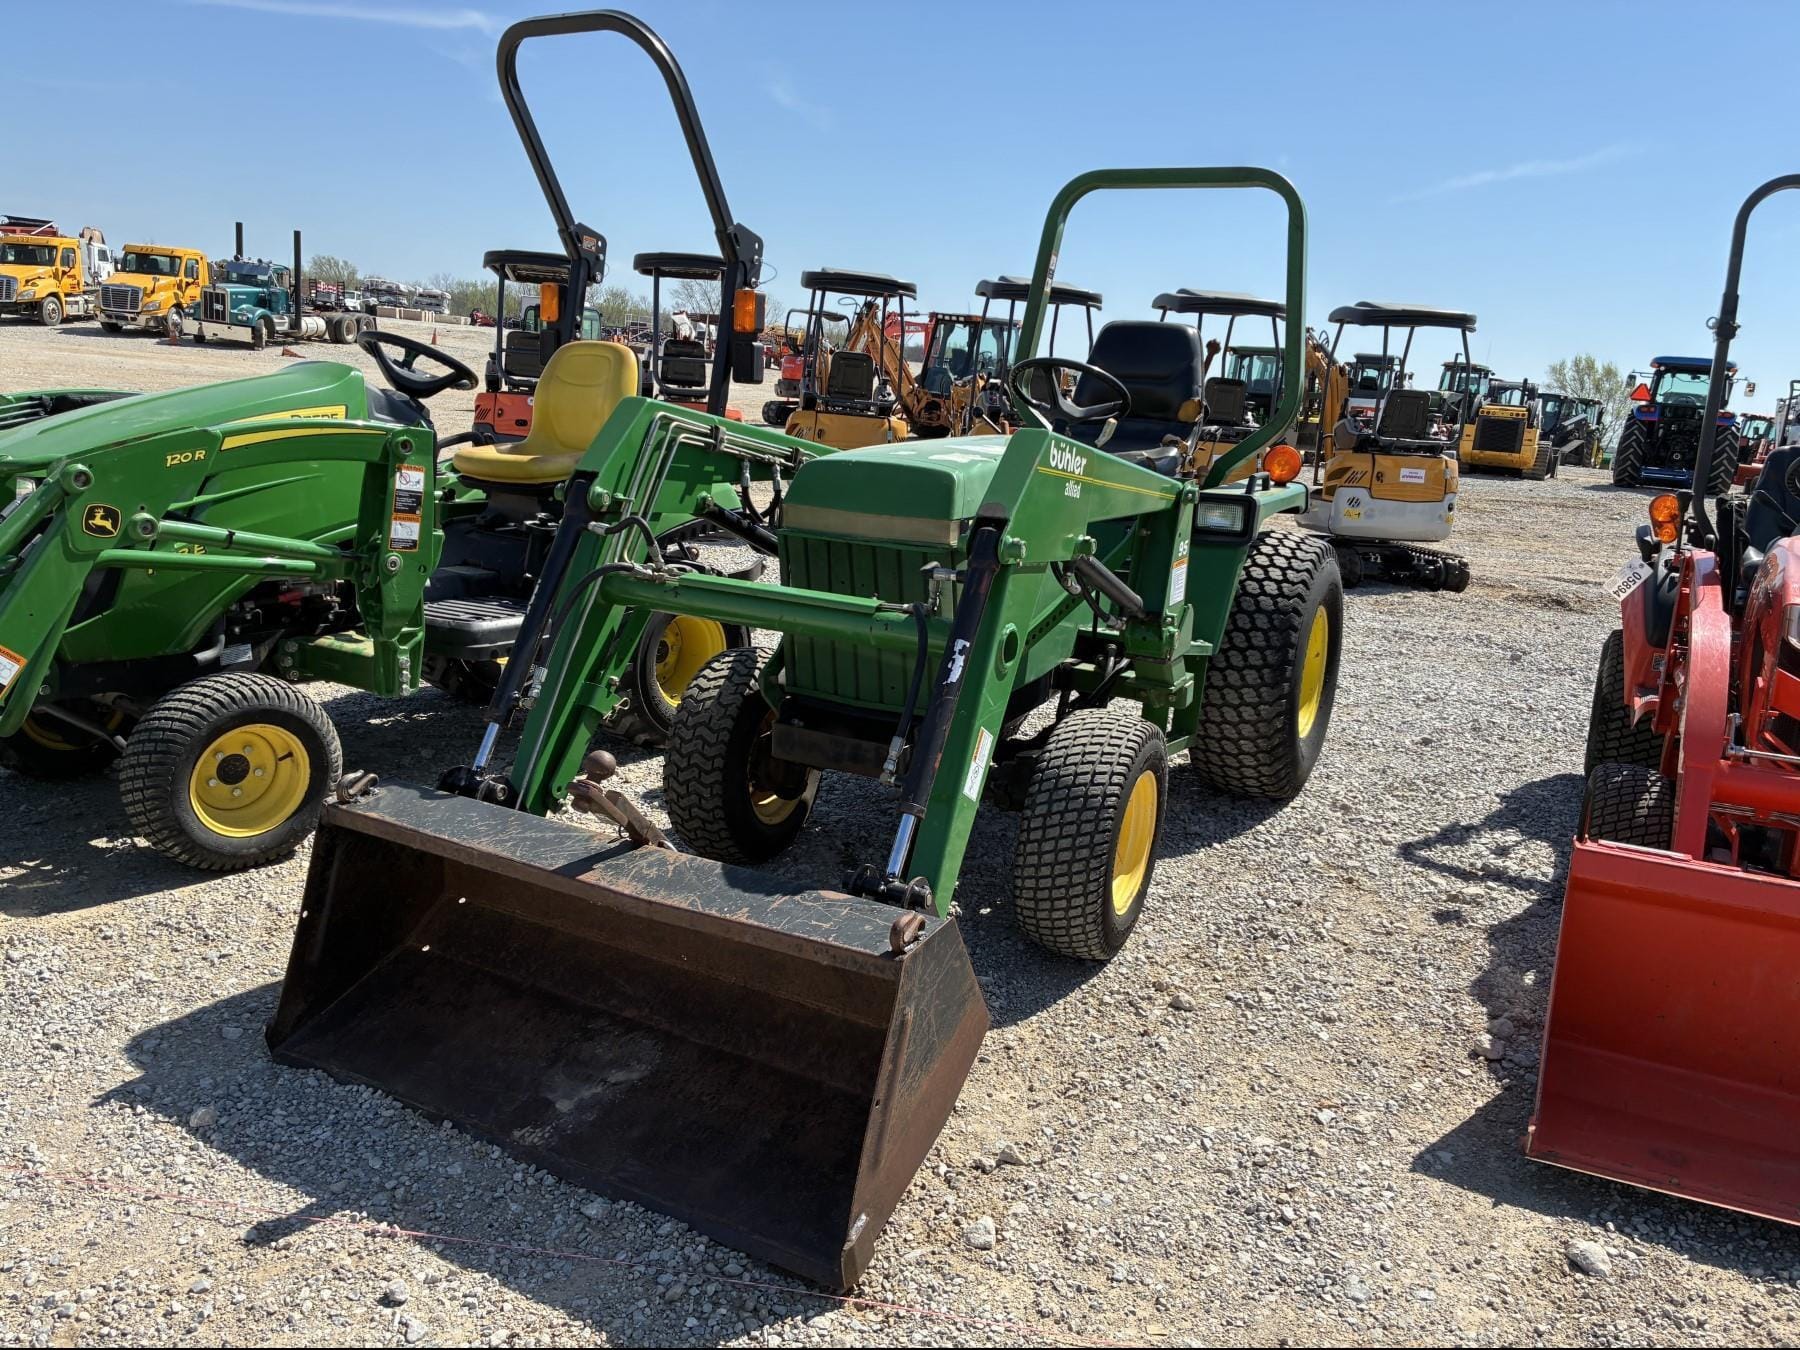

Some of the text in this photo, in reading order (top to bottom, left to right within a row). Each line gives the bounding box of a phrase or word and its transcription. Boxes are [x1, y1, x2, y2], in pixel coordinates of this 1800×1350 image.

[1050, 439, 1087, 476] bühler
[1064, 479, 1082, 499] allied
[1178, 540, 1189, 557] 95
[1612, 571, 1642, 598] 05894
